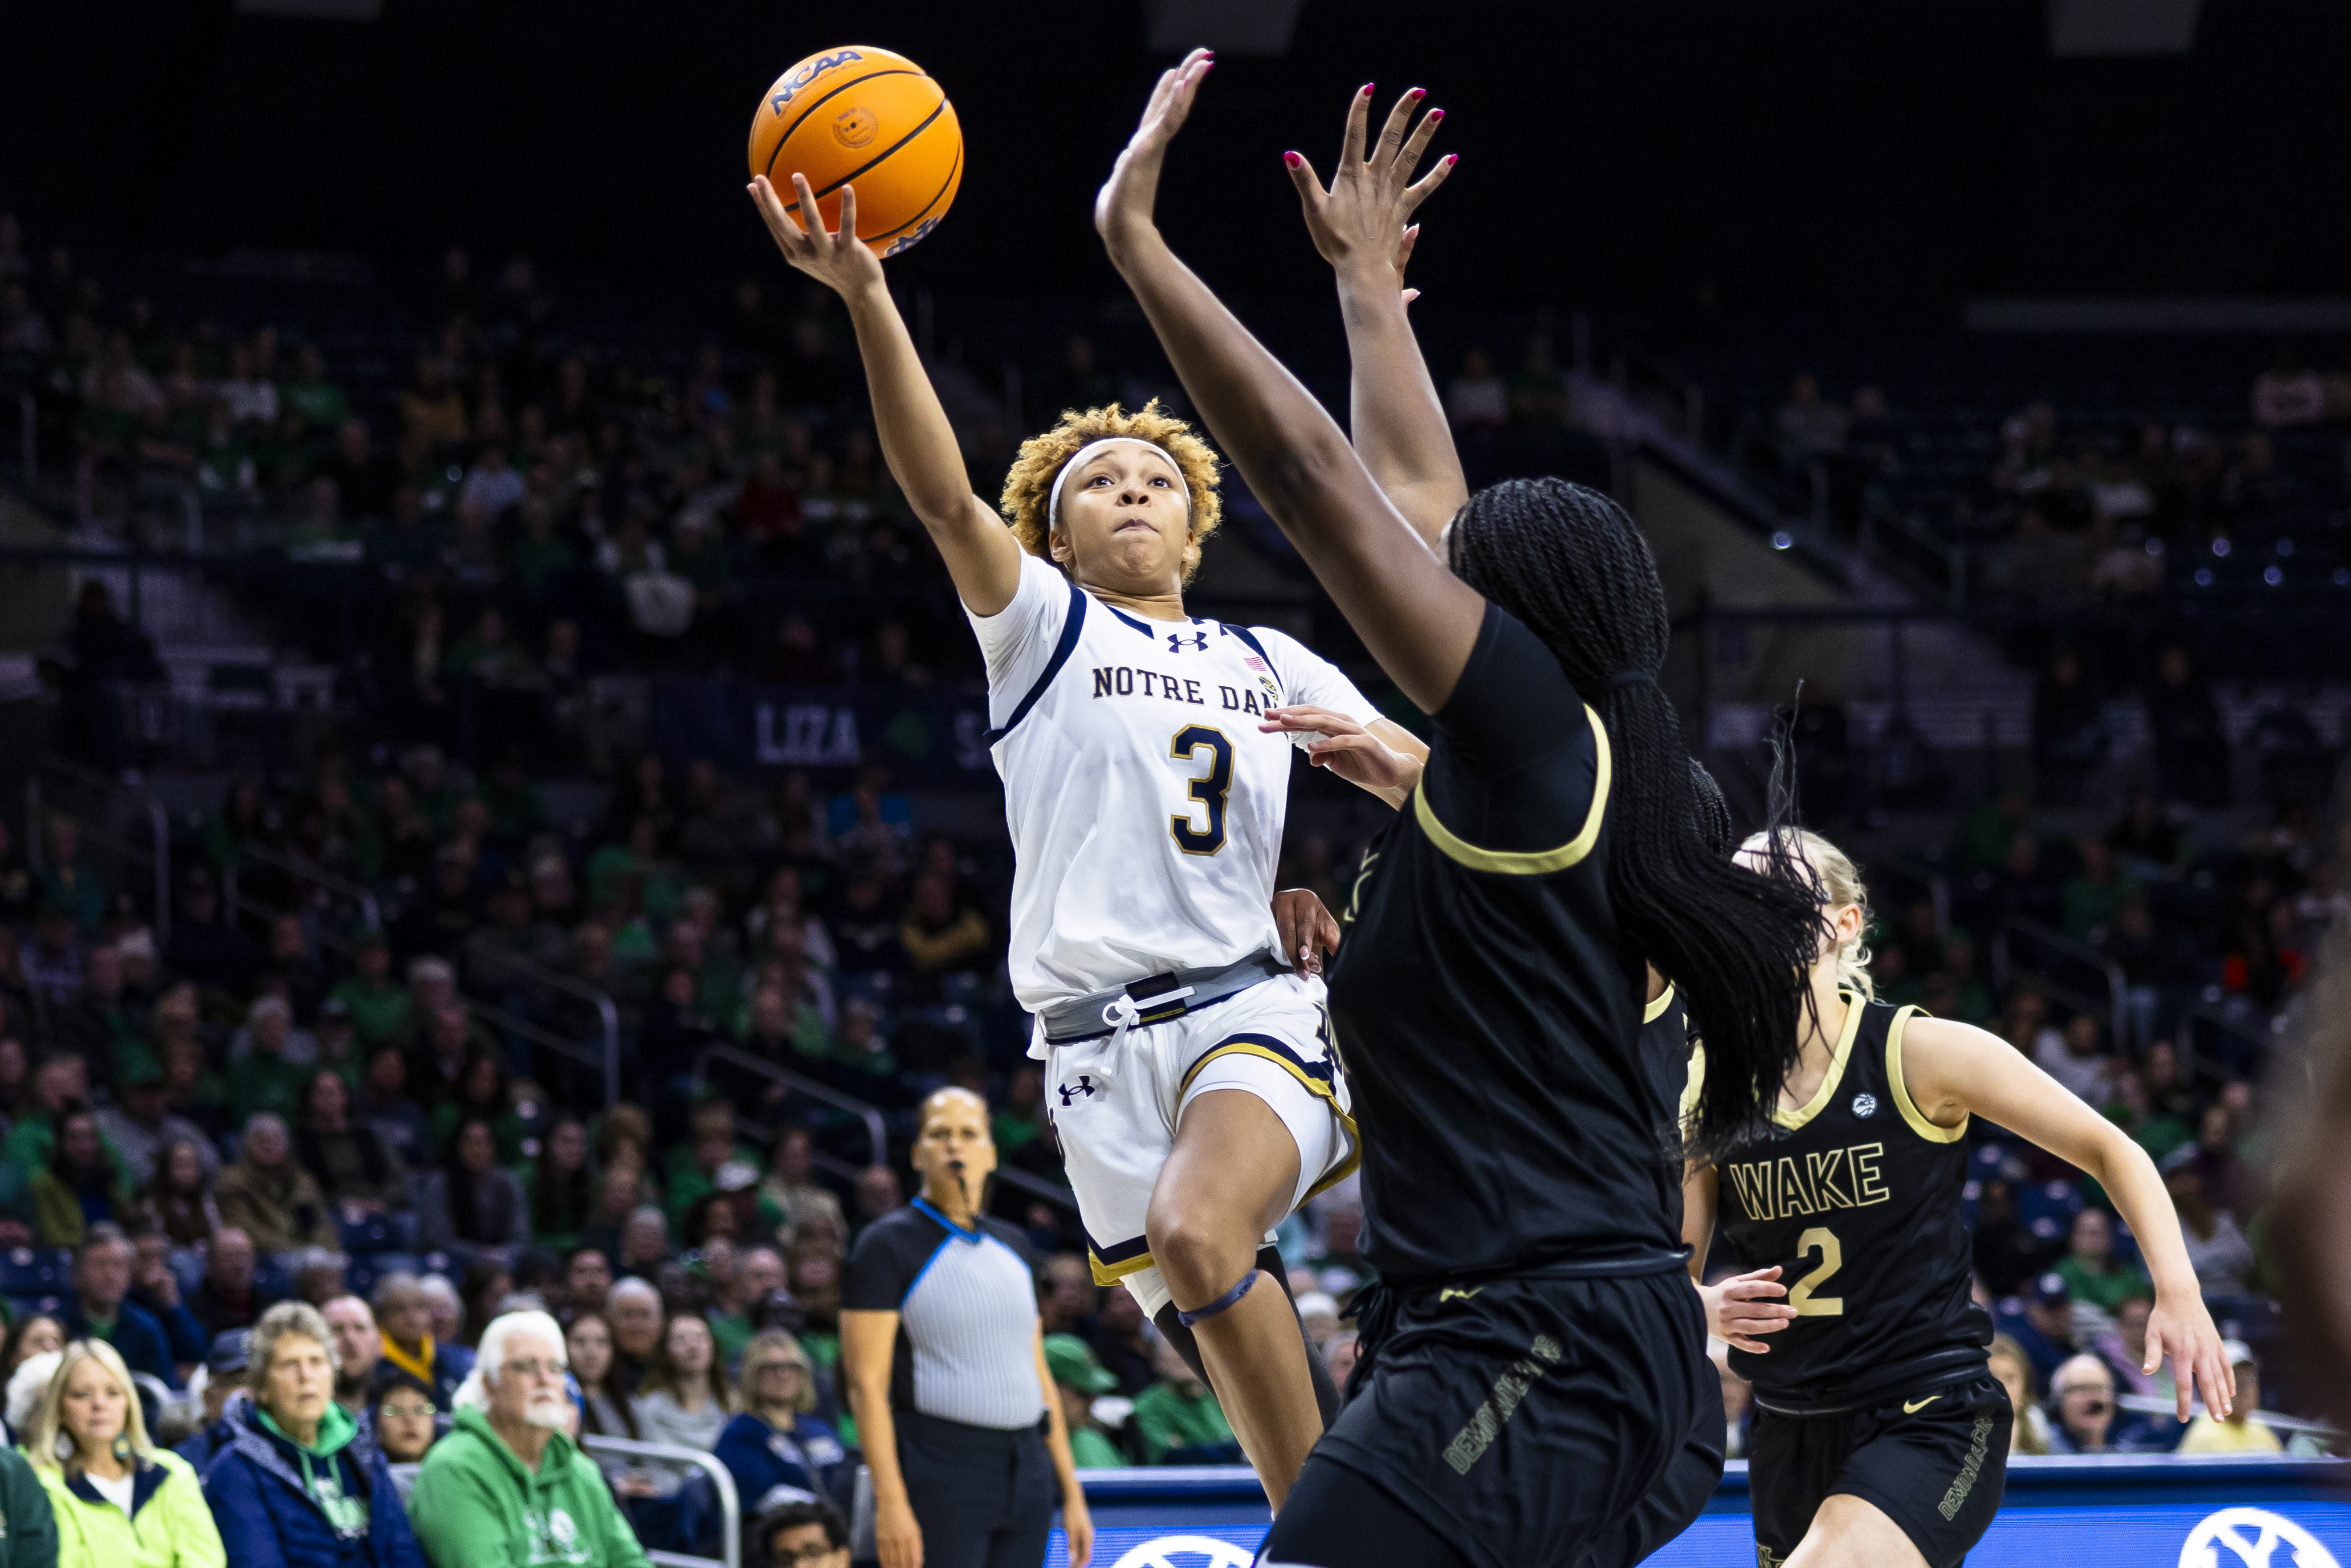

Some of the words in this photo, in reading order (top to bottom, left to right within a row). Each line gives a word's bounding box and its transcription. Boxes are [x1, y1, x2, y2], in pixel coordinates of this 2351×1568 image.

[771, 50, 863, 115] NCAA
[1092, 666, 1204, 706] NOTRE
[753, 701, 861, 766] LIZA
[1170, 723, 1236, 857] 3
[1729, 1142, 1890, 1221] WAKE
[1788, 1226, 1844, 1316] 2
